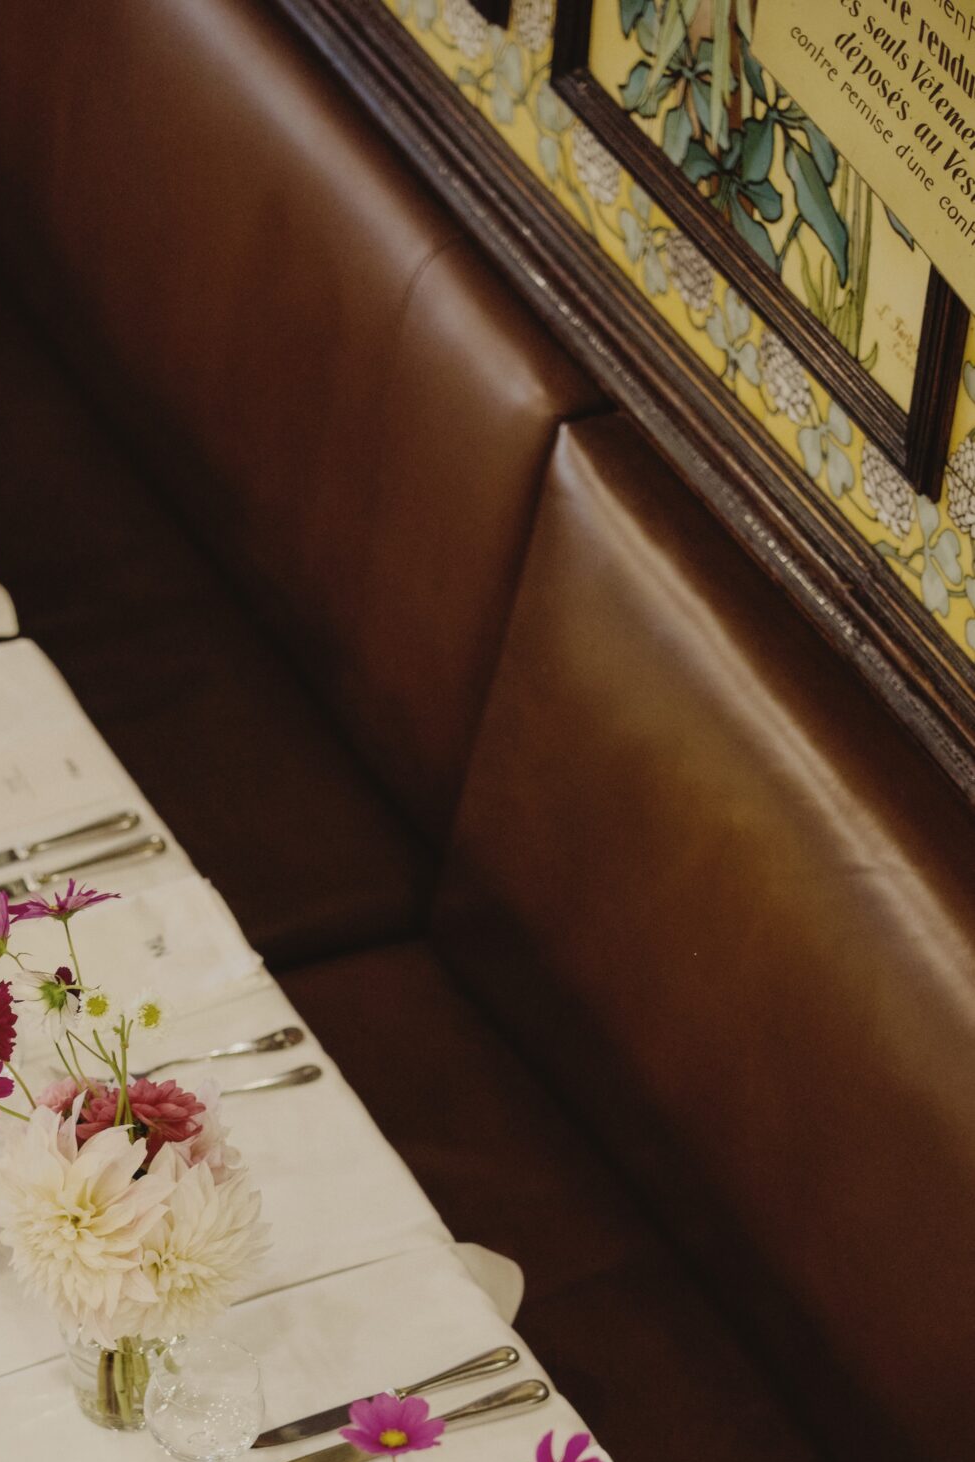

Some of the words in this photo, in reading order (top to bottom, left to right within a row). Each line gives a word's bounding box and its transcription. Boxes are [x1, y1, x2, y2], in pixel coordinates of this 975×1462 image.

[790, 26, 839, 82] contre
[840, 81, 894, 143] remise
[895, 144, 935, 192] d'une
[834, 32, 910, 121] déposés
[913, 122, 944, 156] au
[943, 148, 975, 205] Ves
[863, 15, 910, 71] seuls
